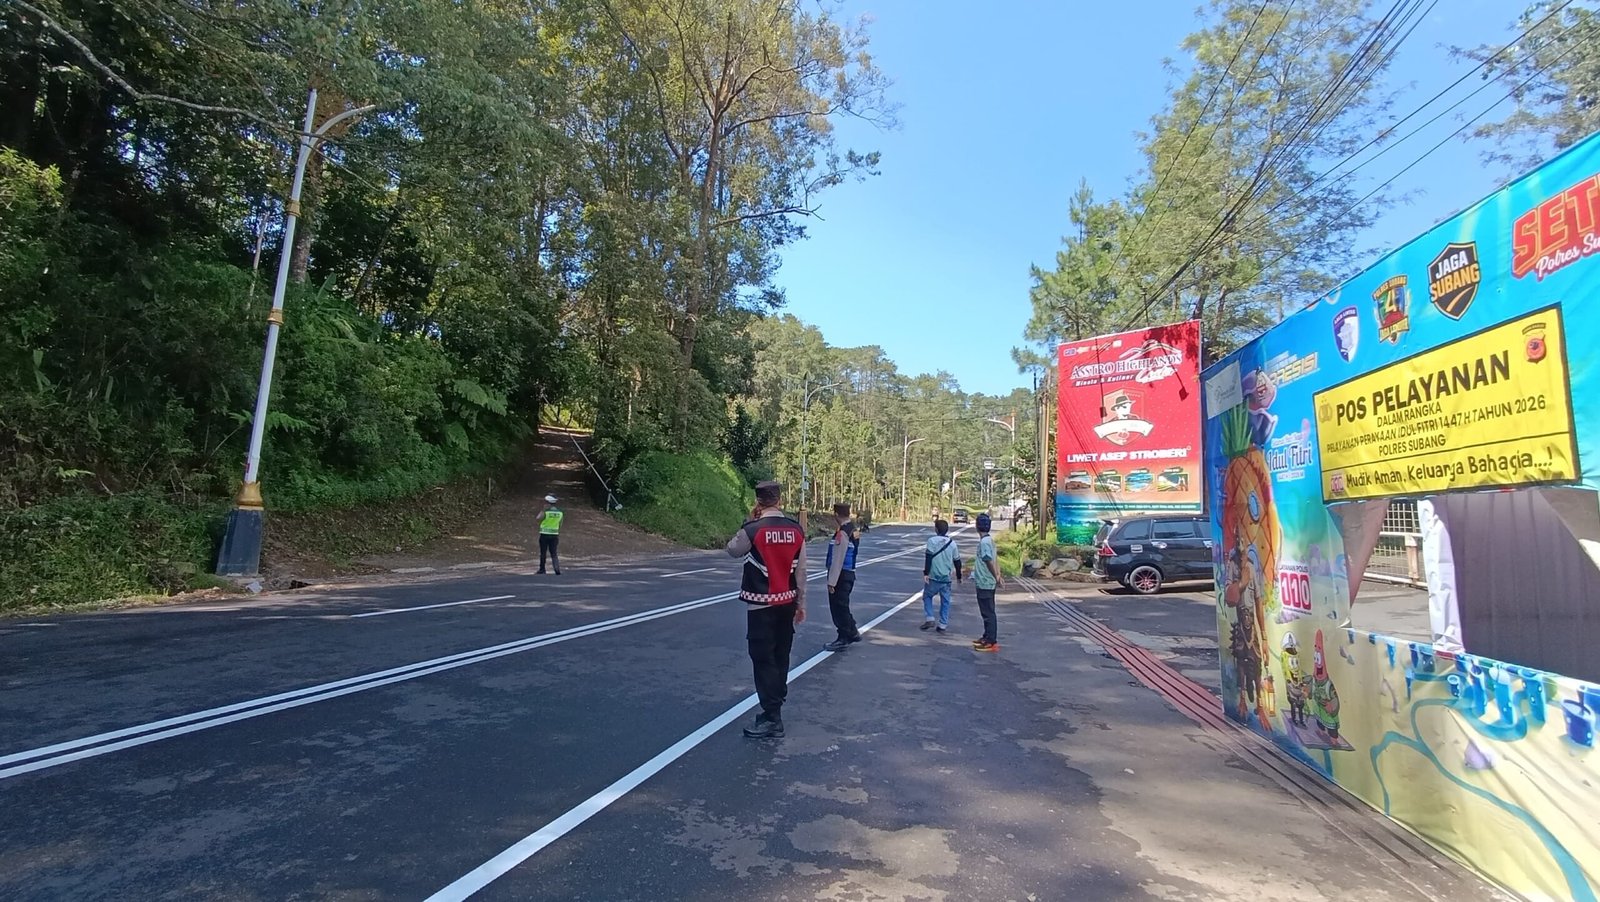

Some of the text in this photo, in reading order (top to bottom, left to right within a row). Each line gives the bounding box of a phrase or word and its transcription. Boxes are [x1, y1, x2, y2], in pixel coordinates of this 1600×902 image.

[1513, 174, 1600, 275] SET
[1436, 251, 1469, 279] JAGA
[1536, 232, 1600, 277] Polres Su
[1430, 264, 1480, 301] SUBANG
[1336, 350, 1510, 426] POS PELAYANAN
[1327, 437, 1359, 453] PELAYANAN
[1360, 428, 1396, 447] PERAYAAN
[1439, 413, 1461, 429] 1447
[1464, 411, 1471, 424] H
[1472, 402, 1513, 422] TAHUN
[1515, 394, 1546, 414] 2026
[1377, 401, 1442, 428] DALAM RANGKA
[1067, 453, 1097, 463] LIWET
[1099, 451, 1127, 462] ASEP
[1289, 443, 1312, 468] Fitri
[1379, 434, 1446, 456] POLRES SUBANG
[1346, 472, 1372, 488] Mudik
[1407, 462, 1464, 481] Keluarga
[765, 530, 795, 543] POLISI
[1280, 573, 1312, 610] 110
